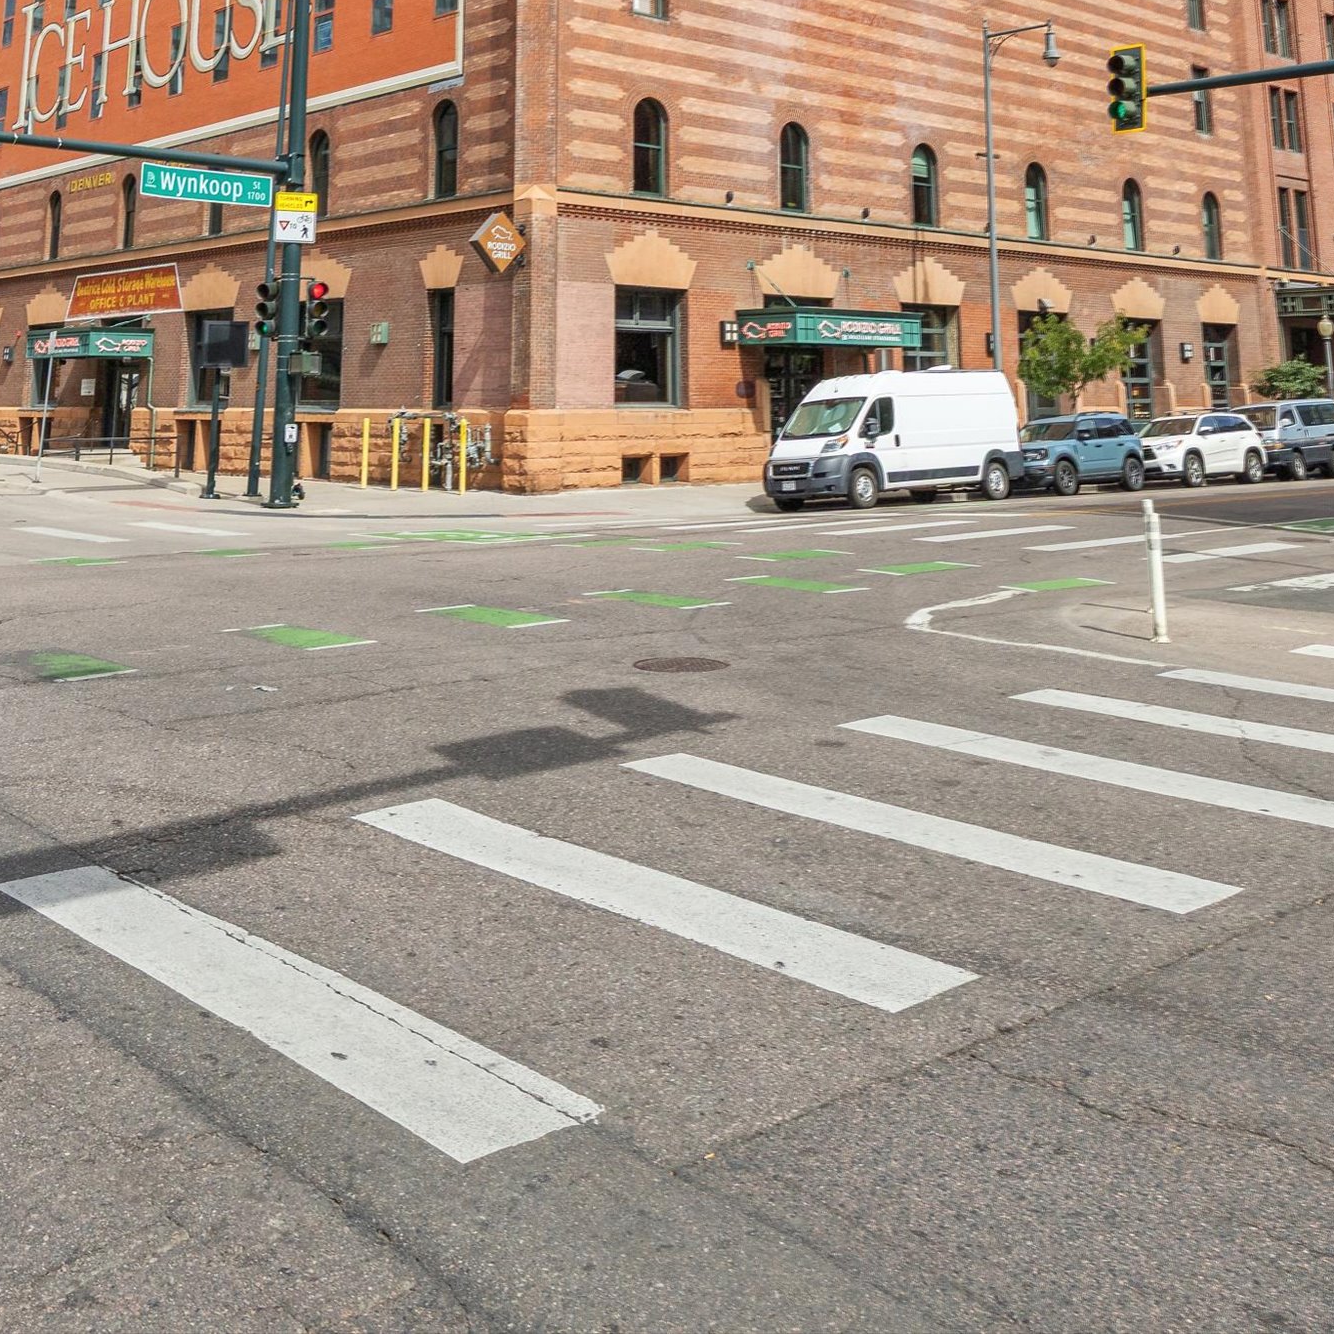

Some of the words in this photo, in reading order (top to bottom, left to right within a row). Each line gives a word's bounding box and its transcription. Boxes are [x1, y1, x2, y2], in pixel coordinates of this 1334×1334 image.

[70, 172, 113, 192] DENVER
[160, 171, 243, 201] Wynkoop
[252, 181, 261, 190] St
[247, 191, 266, 201] 1700
[76, 281, 101, 297] Beatrice
[117, 276, 144, 292] Storage
[144, 273, 176, 289] Warehouse
[89, 296, 116, 309] OFFICE
[127, 293, 155, 306] PLANT
